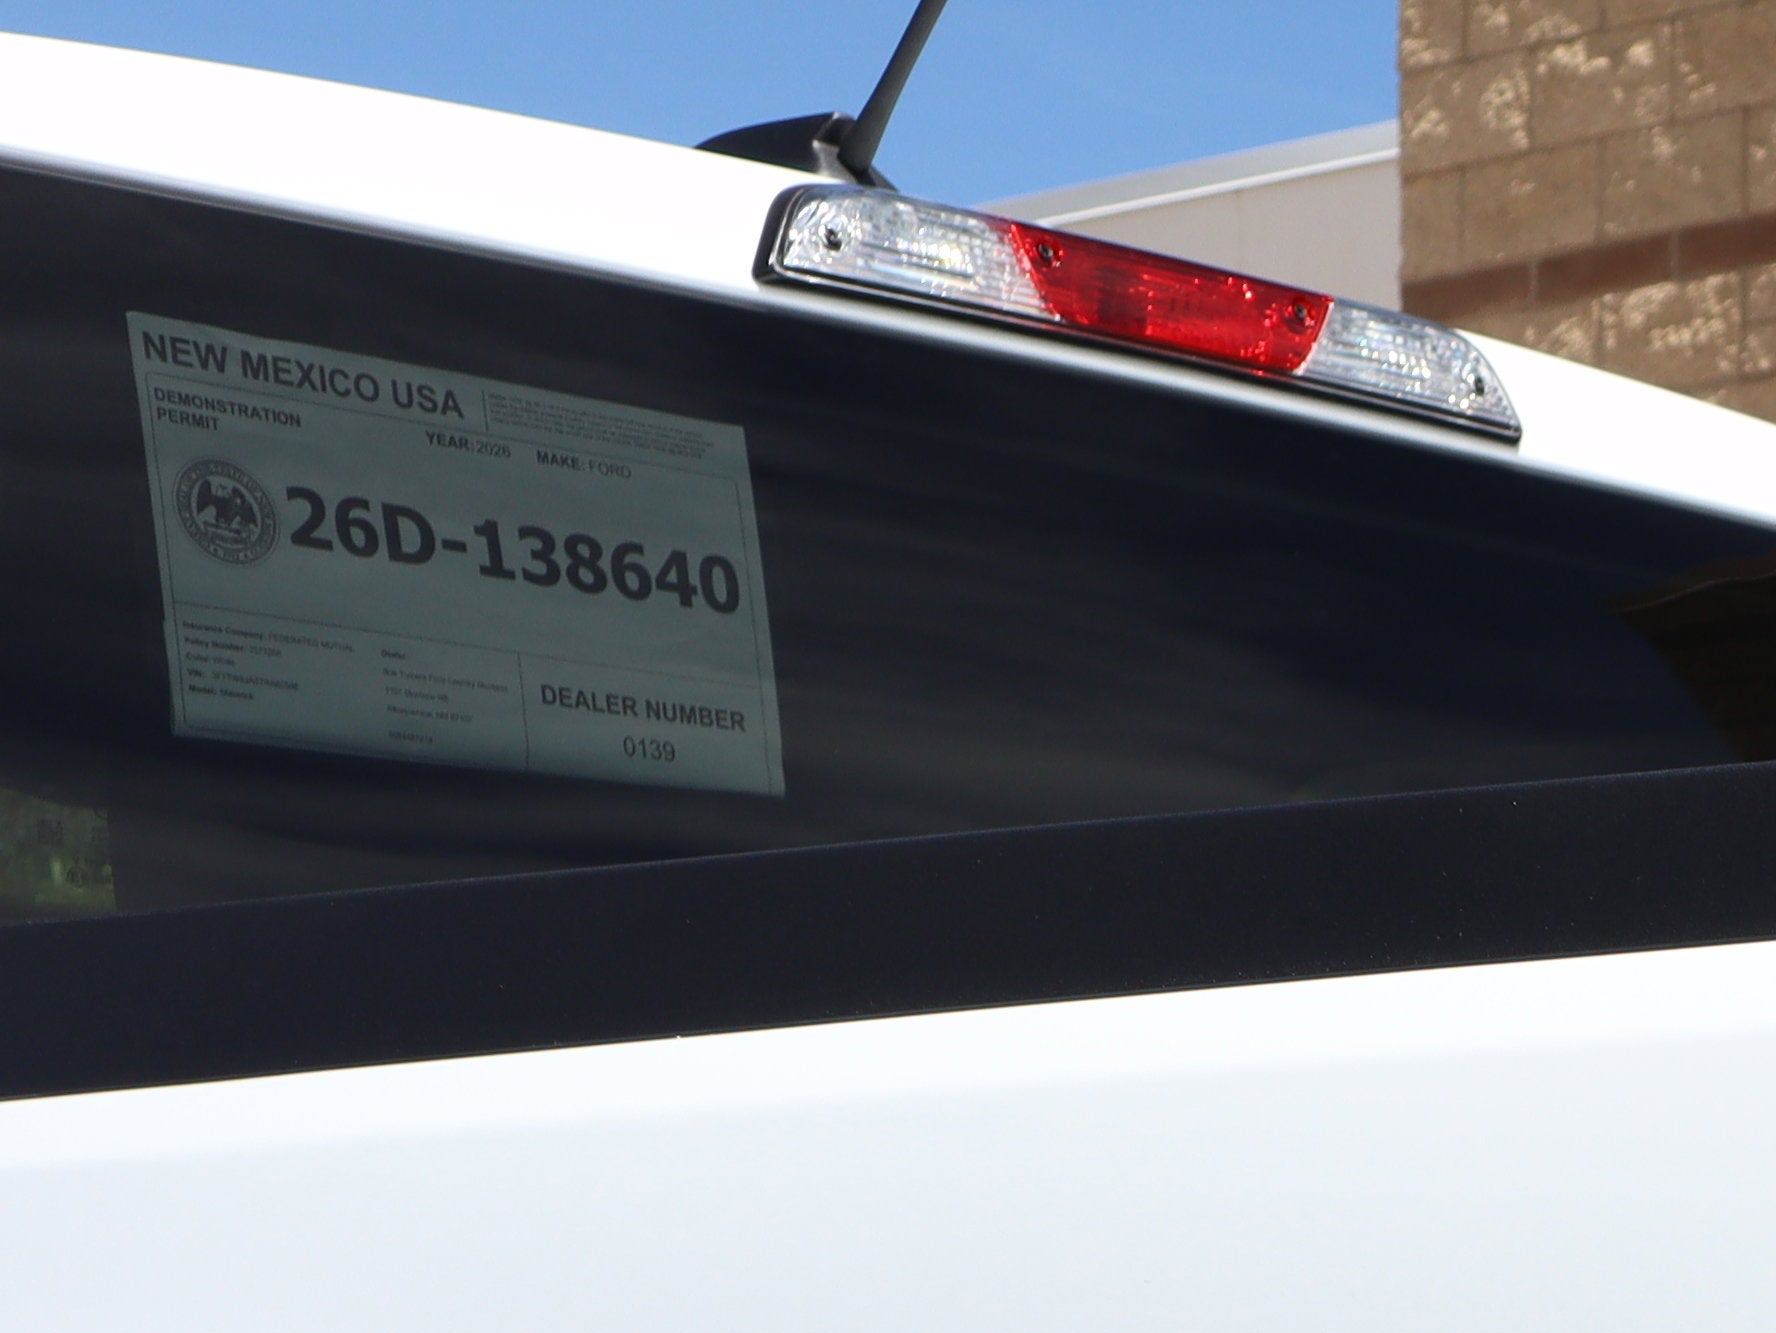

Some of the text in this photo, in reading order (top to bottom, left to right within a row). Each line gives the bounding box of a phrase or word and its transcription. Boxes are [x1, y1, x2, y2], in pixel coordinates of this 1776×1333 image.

[142, 331, 465, 418] NEW MEXICO USA
[153, 386, 302, 428] DEMONSTRATION
[156, 408, 220, 432] PERMIT
[588, 460, 632, 480] FORD
[284, 486, 741, 615] 26D-138640
[540, 683, 746, 733] DEALER NUMBER
[622, 736, 677, 764] 0139
